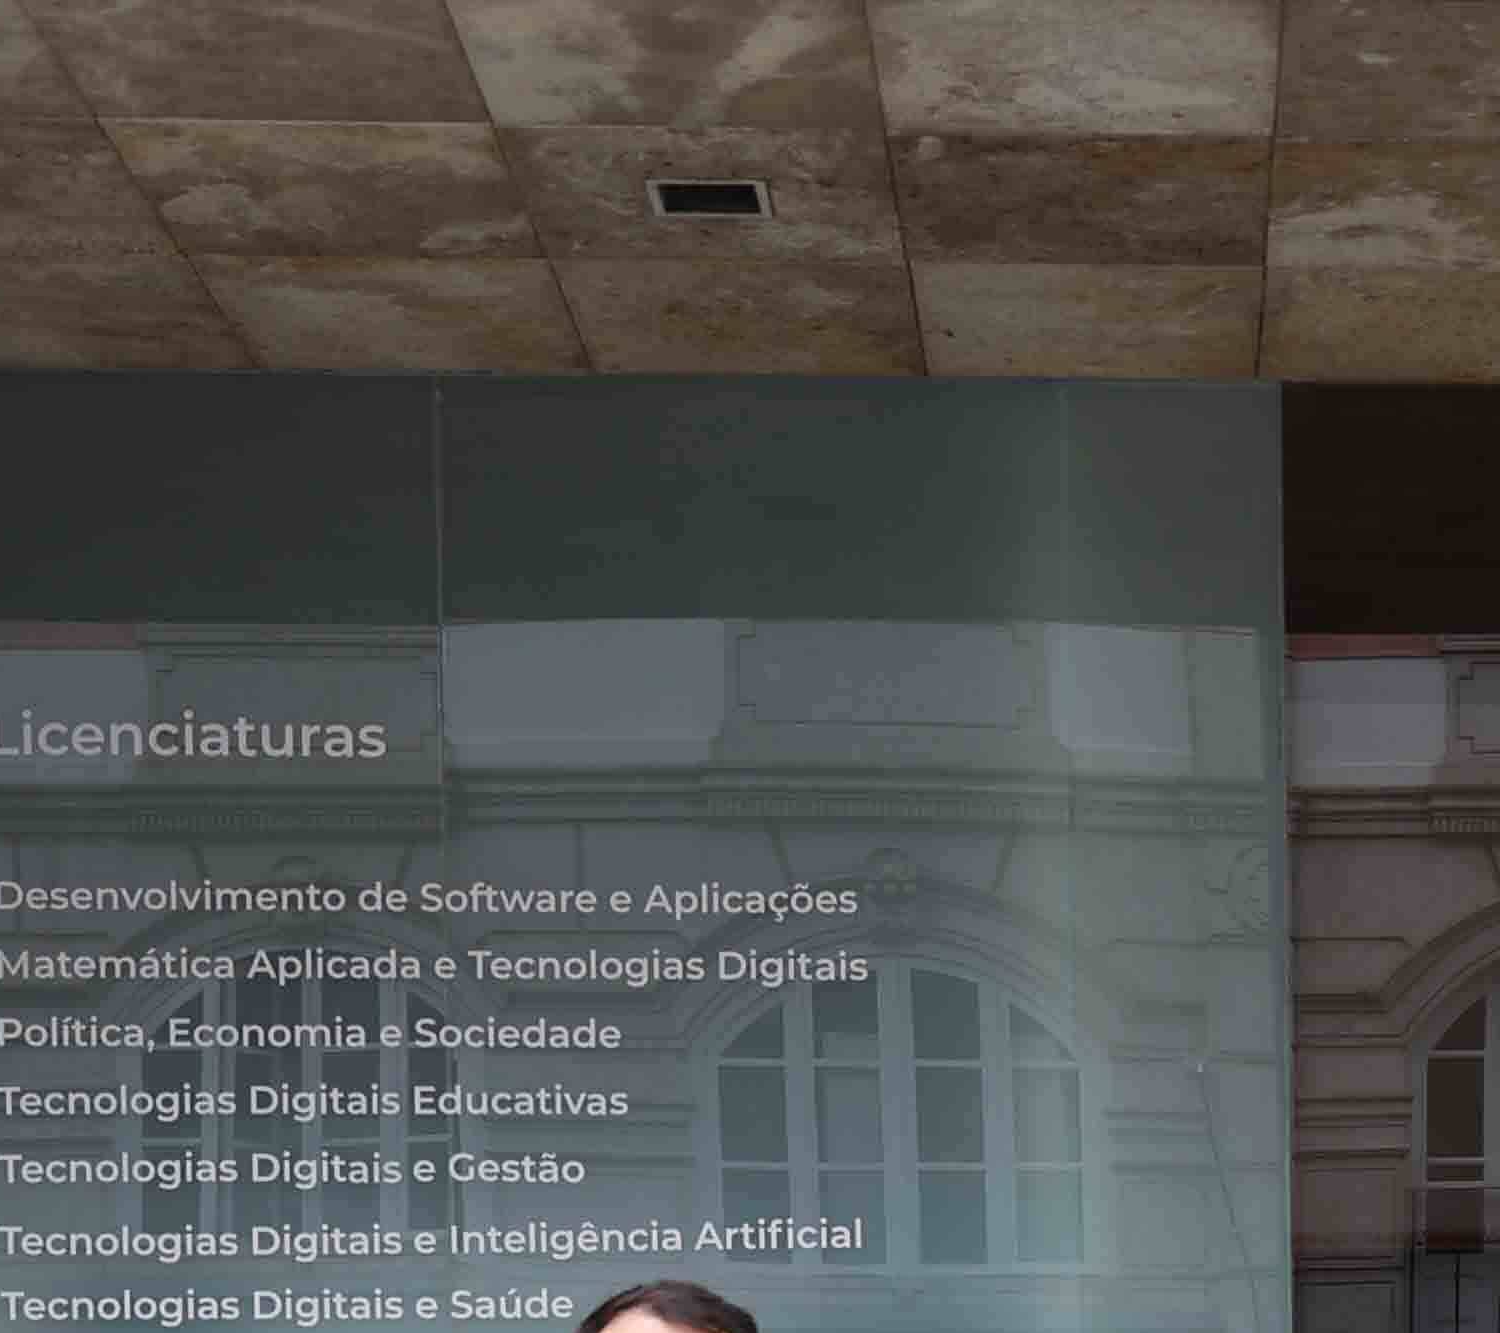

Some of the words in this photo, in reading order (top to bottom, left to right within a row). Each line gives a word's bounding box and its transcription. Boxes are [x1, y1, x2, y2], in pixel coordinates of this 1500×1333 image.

[357, 881, 408, 913] de
[419, 882, 598, 914] Software
[609, 890, 632, 914] e
[643, 882, 858, 923] Aplicações
[247, 948, 422, 986] Aplicada
[433, 956, 458, 980] e
[467, 949, 706, 988] Tecnologias
[717, 949, 869, 988] Digitais
[169, 1016, 366, 1048] Economia
[378, 1023, 403, 1048] e
[413, 1016, 623, 1049] Sociedade
[249, 1083, 401, 1123] Digitais
[413, 1083, 629, 1117] Educativas
[251, 1151, 403, 1191] Digitais
[412, 1160, 437, 1184] e
[448, 1151, 587, 1185] Gestão
[251, 1224, 403, 1264] Digitais
[412, 1232, 438, 1256] e
[450, 1220, 683, 1261] Inteligência
[694, 1217, 865, 1252] Artificial
[0, 1289, 241, 1329] Tecnologias
[252, 1288, 404, 1328] Digitais
[414, 1297, 439, 1321] e
[450, 1287, 574, 1321] Saúde
